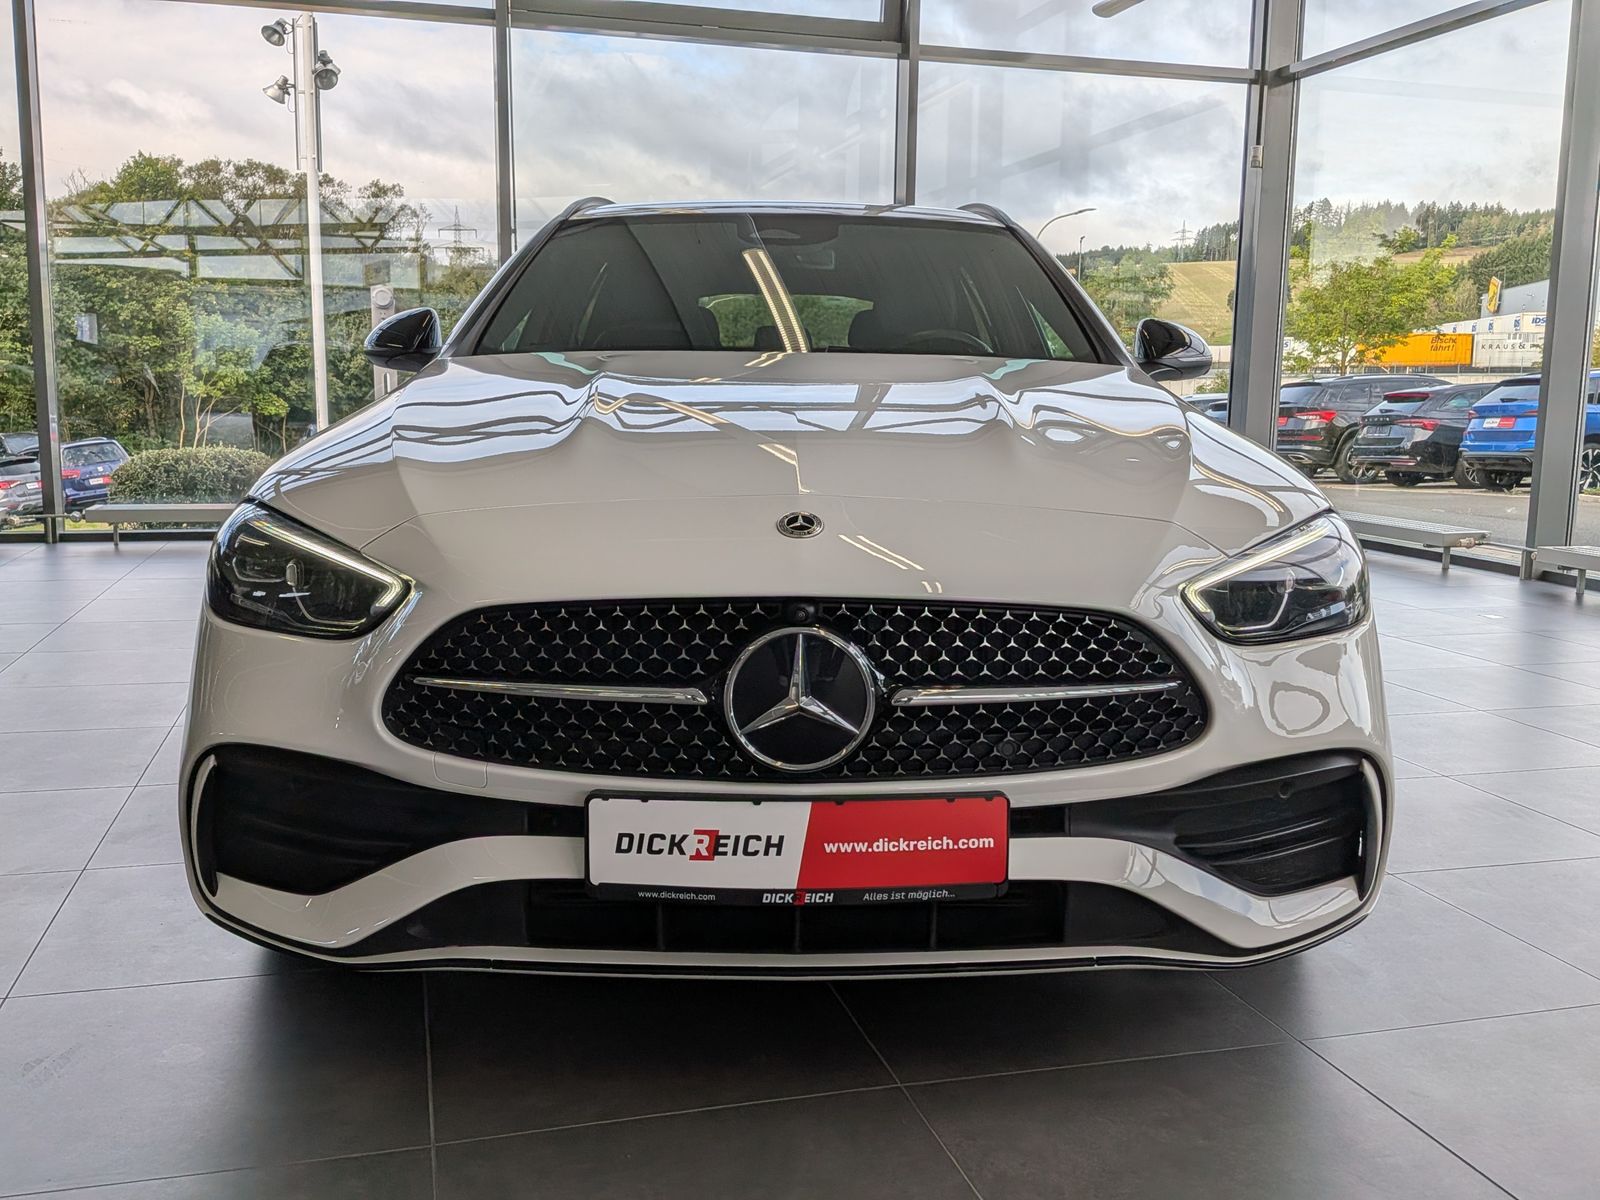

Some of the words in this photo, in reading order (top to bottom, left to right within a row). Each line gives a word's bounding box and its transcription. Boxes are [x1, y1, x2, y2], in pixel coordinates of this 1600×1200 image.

[1518, 342, 1526, 350] &
[615, 830, 785, 860] DICKREICH
[824, 836, 995, 853] www.dickreich.com
[637, 890, 716, 901] www.dickreich.com
[862, 892, 889, 901] Alles
[890, 891, 906, 900] ist
[907, 888, 956, 901] möglich...
